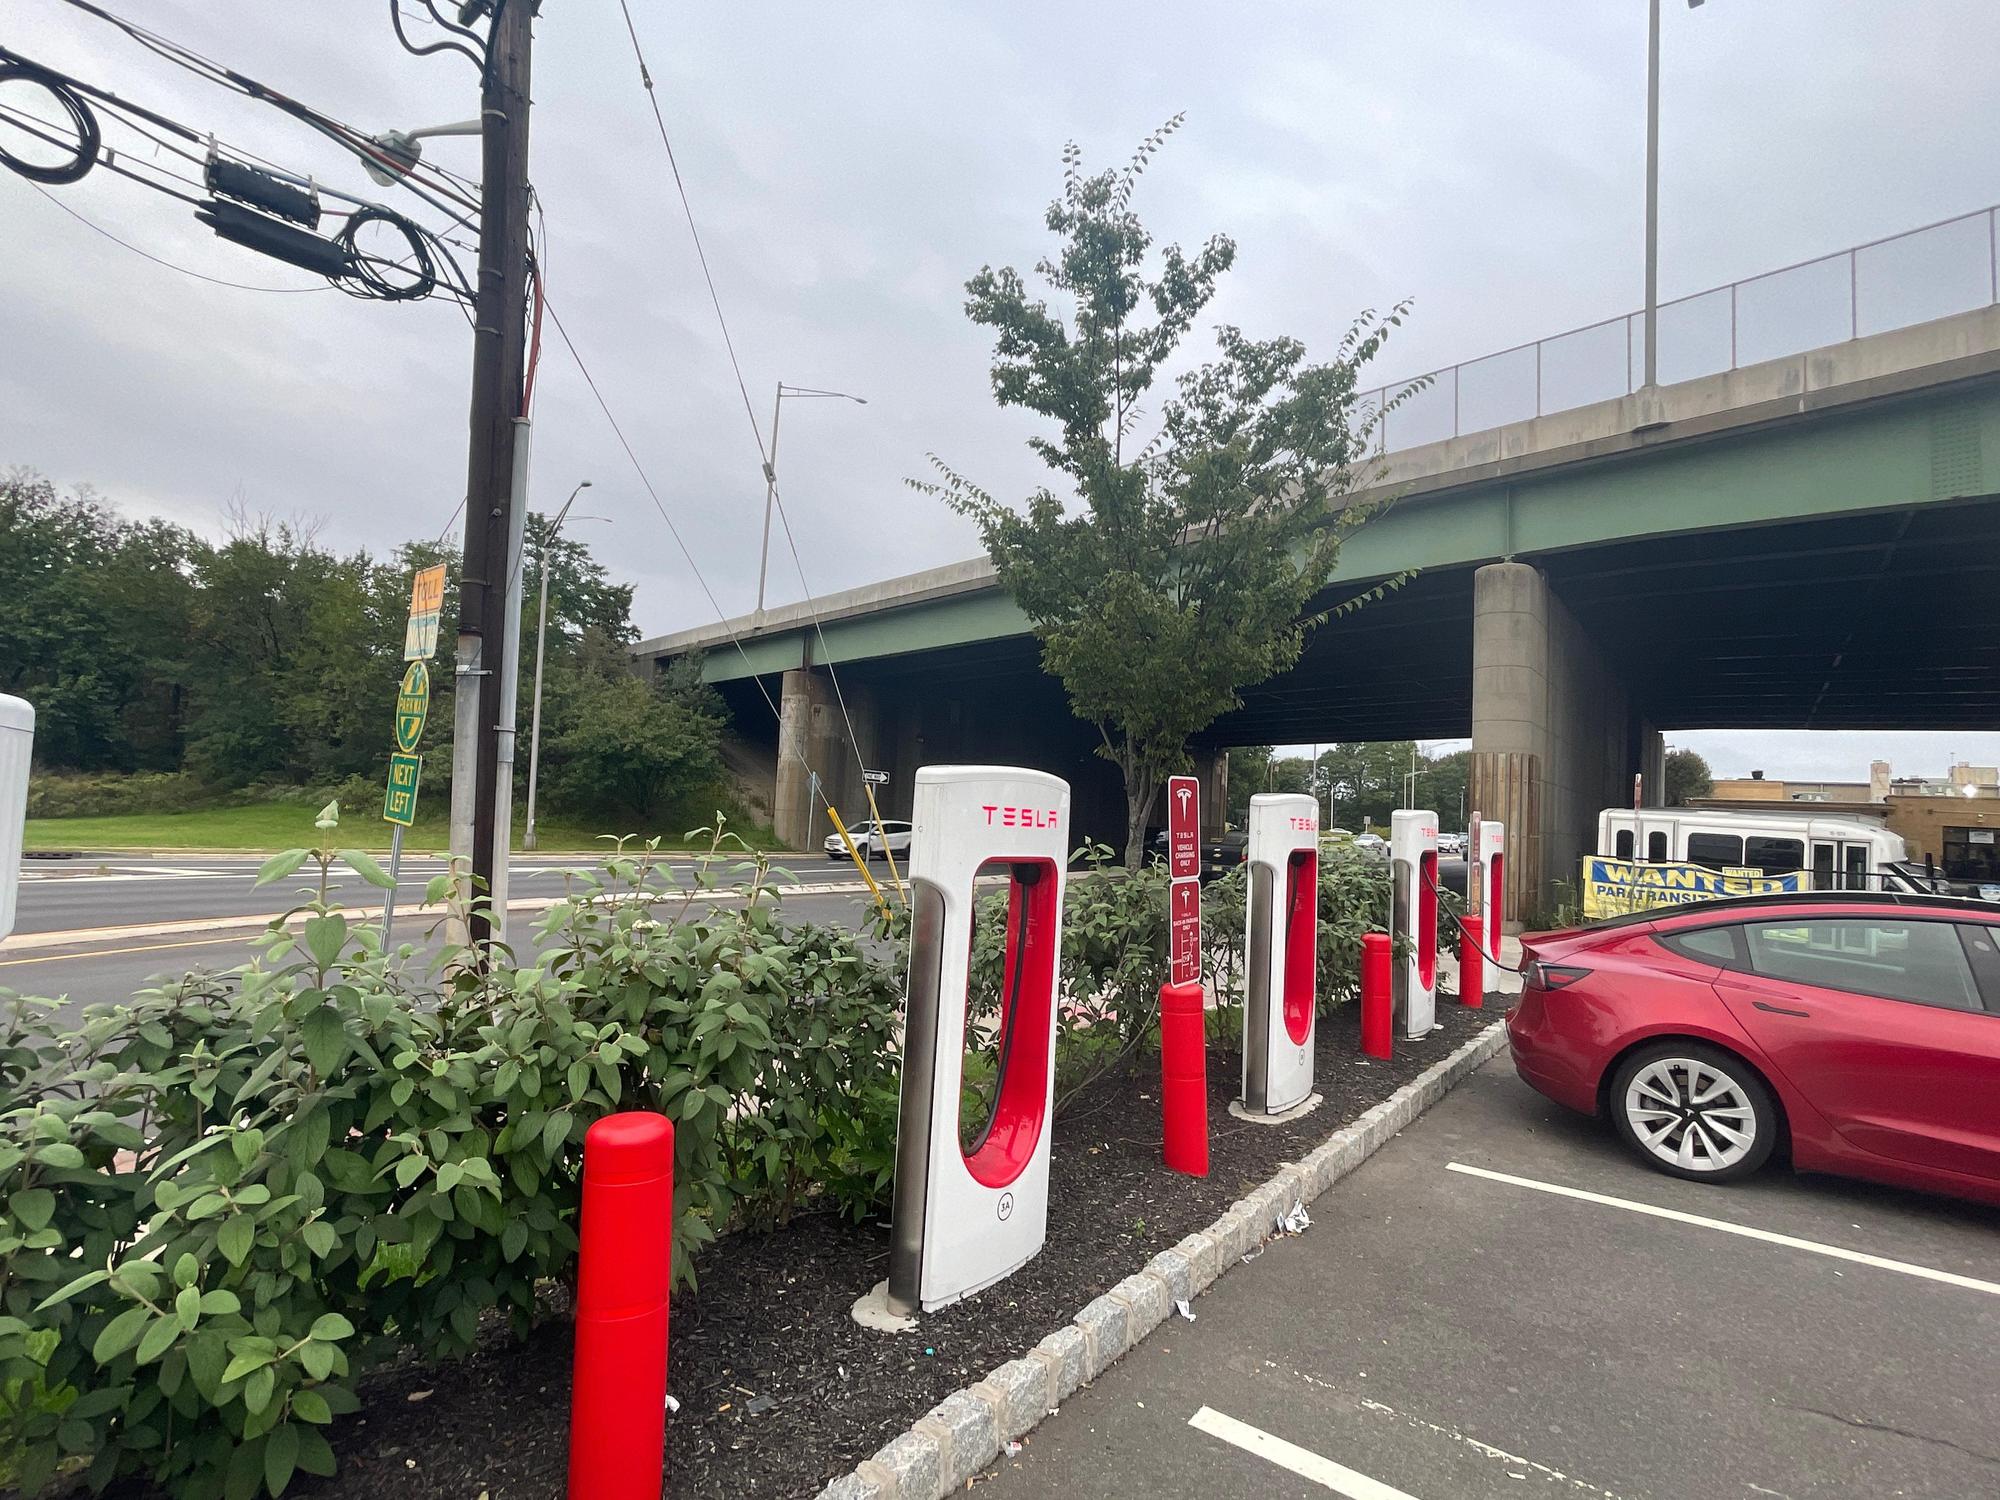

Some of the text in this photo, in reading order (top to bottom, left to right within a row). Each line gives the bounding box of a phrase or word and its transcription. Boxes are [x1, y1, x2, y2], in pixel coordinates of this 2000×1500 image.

[417, 579, 439, 602] TOLL
[400, 697, 425, 714] PARKWAY
[393, 763, 415, 787] NEXT
[390, 790, 410, 815] LEFT
[982, 806, 1057, 828] TESLA
[1175, 851, 1195, 859] CHARGING
[1177, 843, 1193, 851] VEHICLE
[1604, 863, 1784, 896] WANTED
[1725, 869, 1760, 878] WANTED
